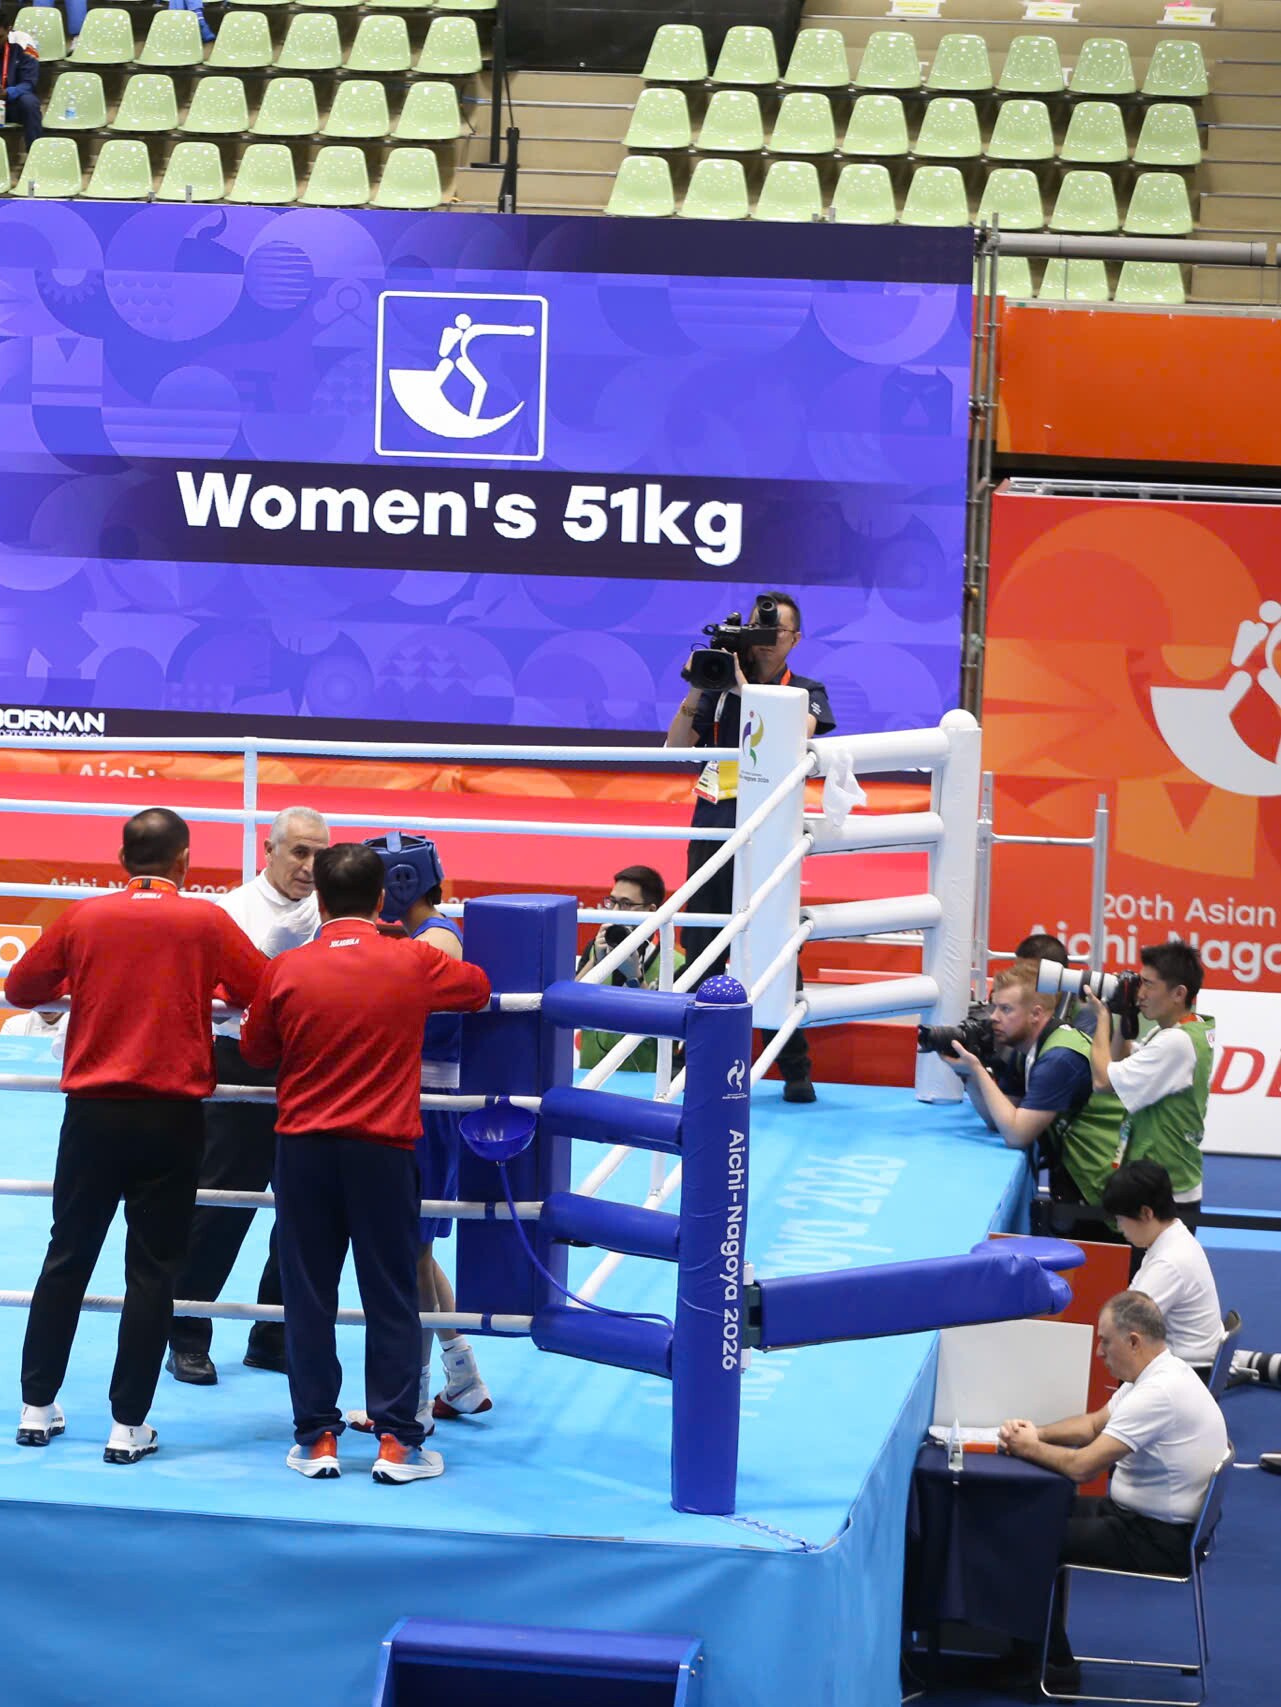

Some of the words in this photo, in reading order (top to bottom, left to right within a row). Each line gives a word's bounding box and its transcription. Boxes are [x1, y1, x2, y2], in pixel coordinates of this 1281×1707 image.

[176, 471, 537, 539] Women's
[562, 483, 743, 566] 51kg
[1103, 893, 1174, 922] 20th
[1184, 898, 1276, 927] Asian
[1211, 1046, 1281, 1098] D
[719, 1129, 745, 1301] Aichi-Nagoya
[722, 1308, 740, 1371] 2026
